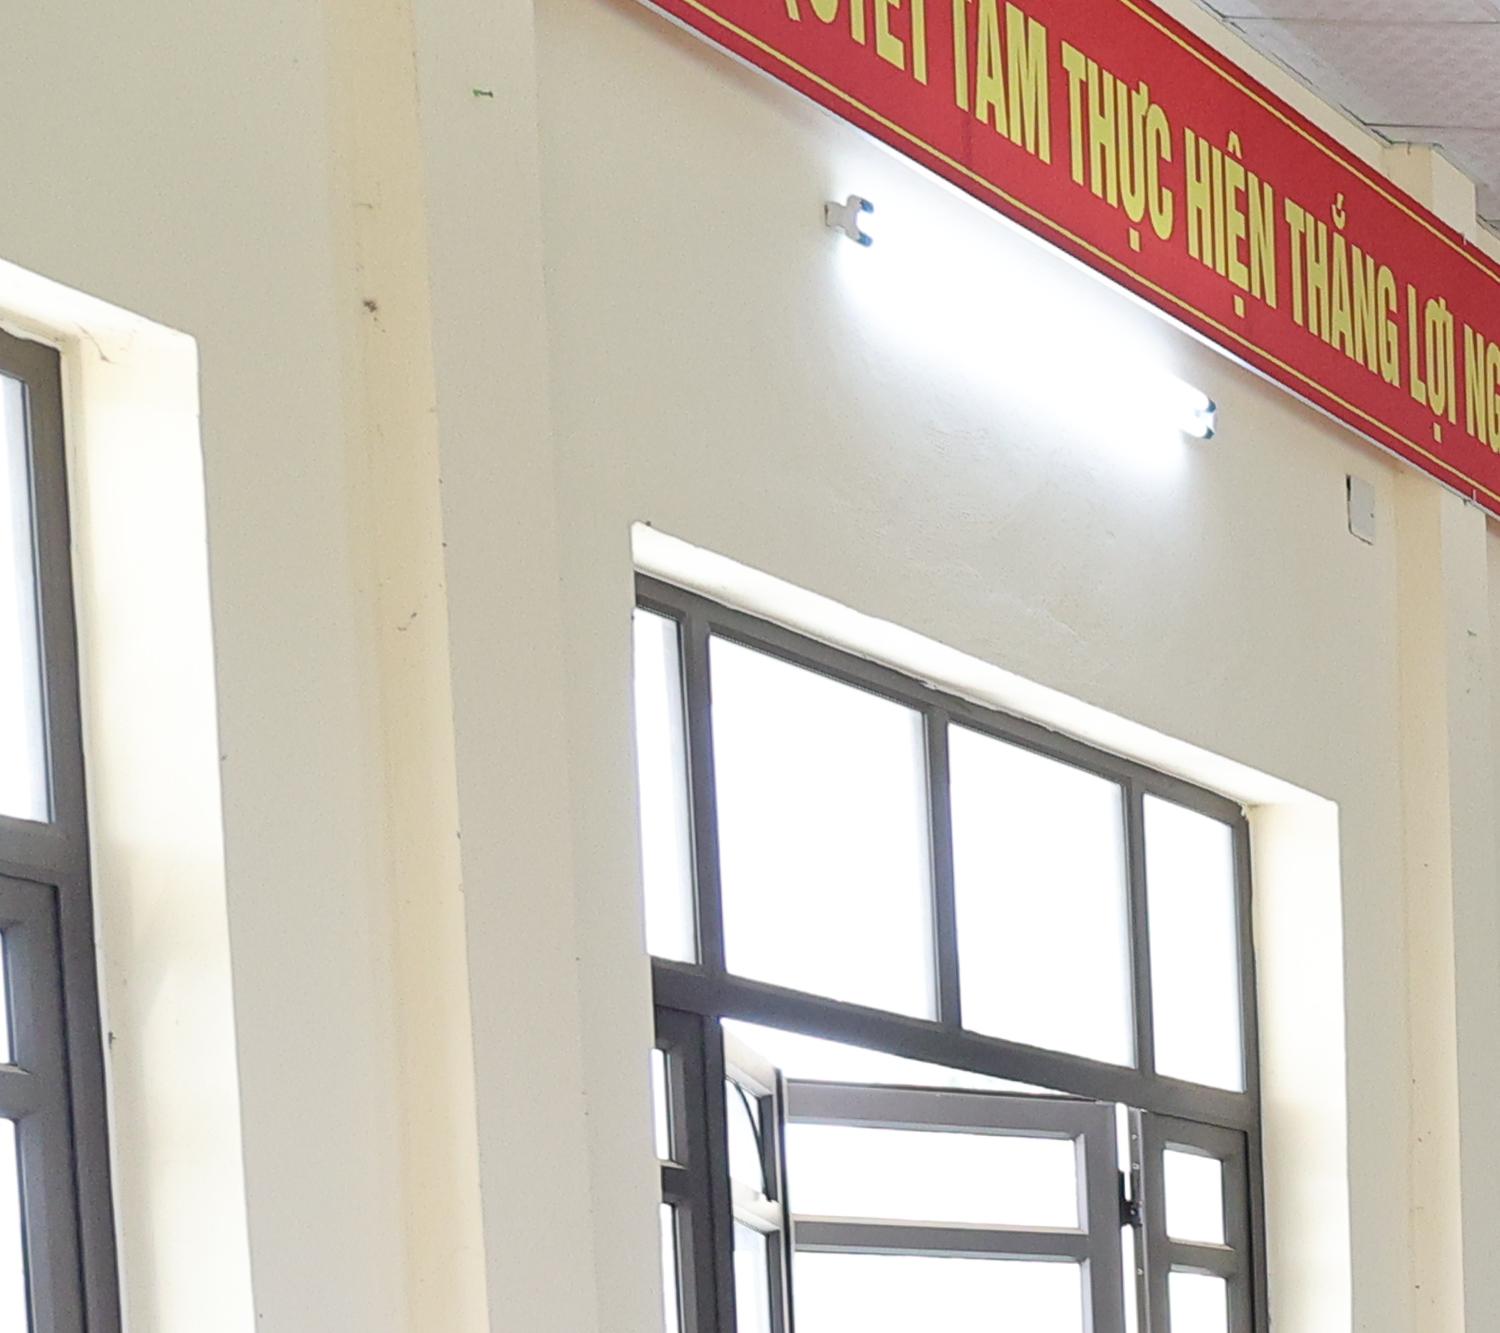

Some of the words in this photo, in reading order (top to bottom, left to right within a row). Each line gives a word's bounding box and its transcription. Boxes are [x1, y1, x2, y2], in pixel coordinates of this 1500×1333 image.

[1061, 41, 1173, 251] THỰC
[1184, 127, 1277, 318] HIỆN
[1285, 192, 1400, 389] THẮNG
[1407, 284, 1457, 442] LỢI
